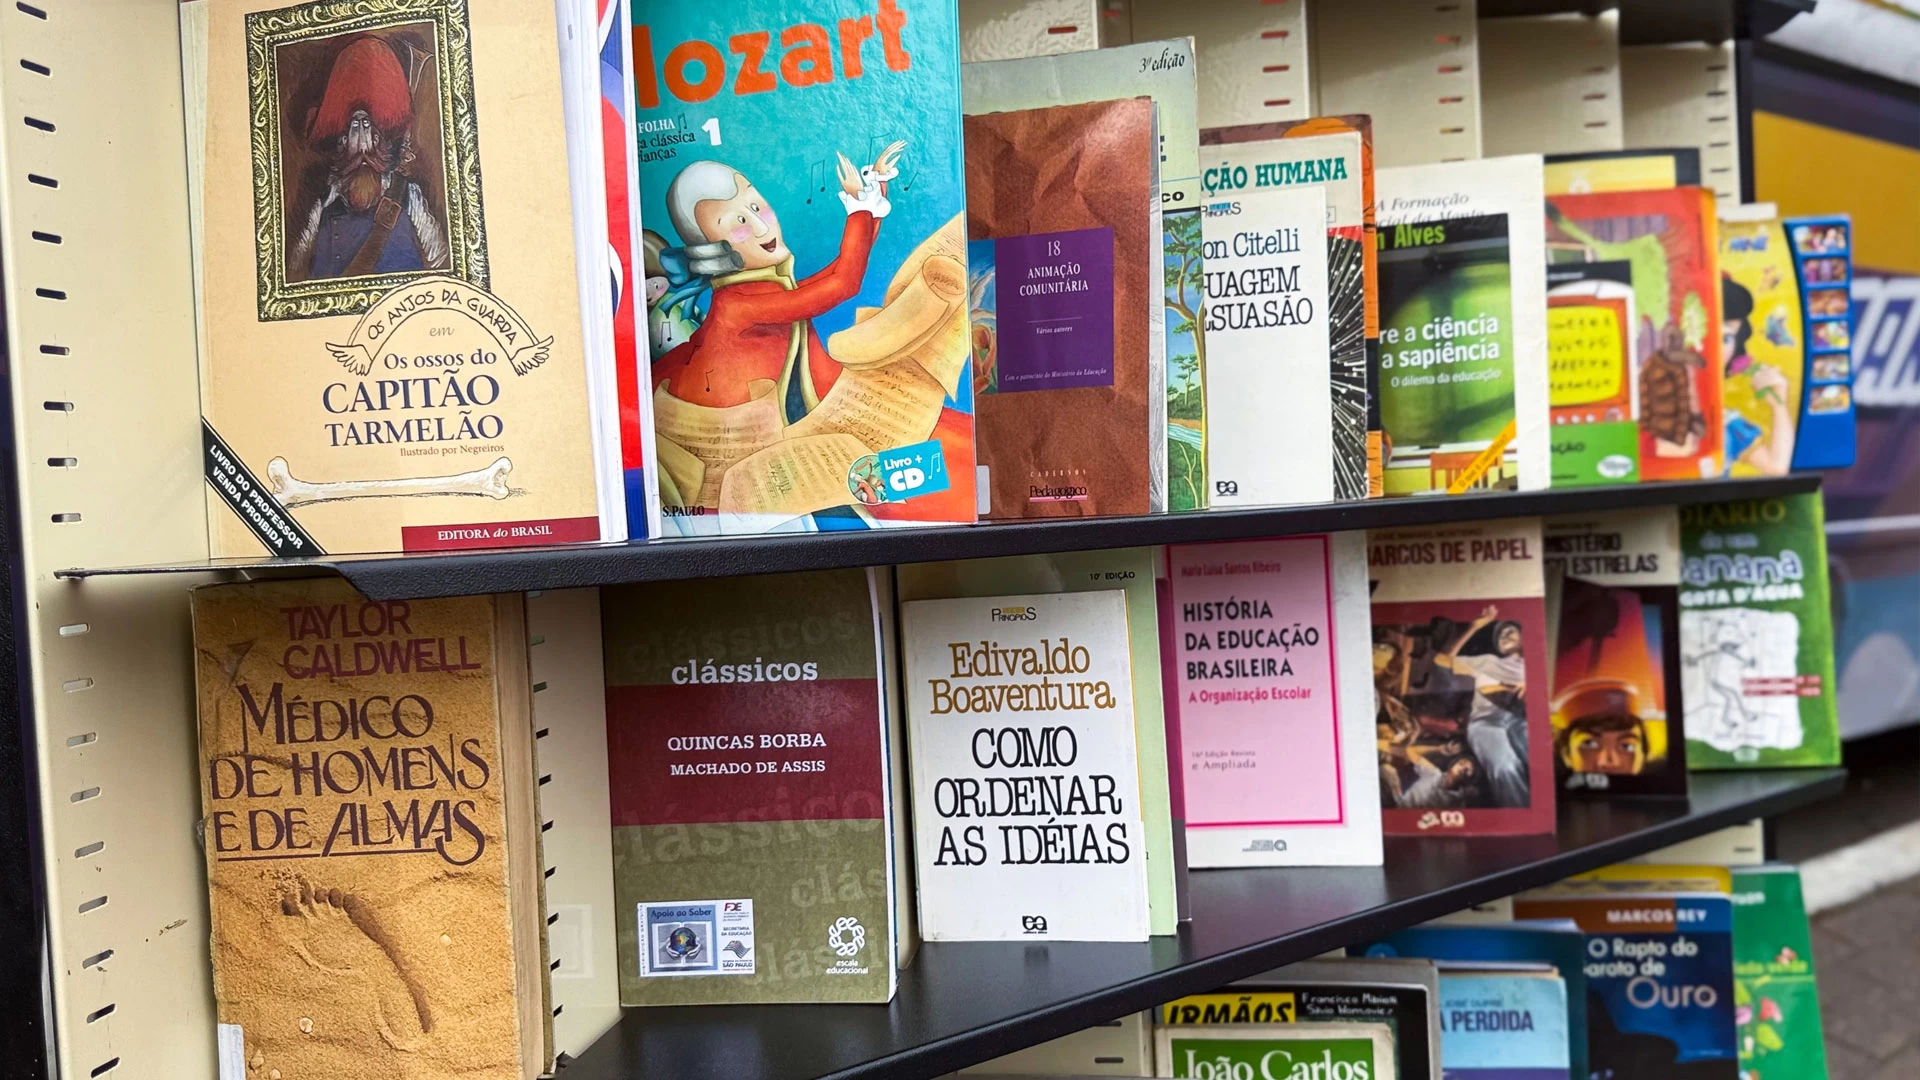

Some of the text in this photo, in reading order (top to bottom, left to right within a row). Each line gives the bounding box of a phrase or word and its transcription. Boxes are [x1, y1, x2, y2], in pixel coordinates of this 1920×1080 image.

[632, 0, 912, 109] ozart
[1152, 47, 1185, 71] edição
[638, 118, 676, 134] FOLHA
[701, 117, 722, 146] 1
[650, 131, 696, 148] clássica
[638, 147, 677, 163] ianças
[1200, 157, 1348, 197] ÇÃO HUMANA
[1375, 193, 1469, 211] A Formação
[1376, 214, 1407, 227] cial
[1233, 228, 1301, 257] Citelli
[1394, 223, 1446, 248] Alves
[1047, 240, 1061, 257] 18
[1027, 262, 1081, 279] ANIMAÇÃO
[1204, 265, 1301, 299] UAGEM
[1019, 278, 1089, 296] COMUNITÁRIA
[388, 290, 435, 324] ANJOS
[442, 289, 462, 305] DA
[467, 298, 518, 345] GUARDA
[1404, 326, 1416, 342] a
[1422, 313, 1499, 341] ciência
[429, 326, 455, 338] em
[384, 349, 497, 370] Os ossos do
[1382, 338, 1501, 369] a sapiência
[1391, 369, 1501, 387] O dilema da educação
[322, 369, 500, 414] CAPITÃO
[324, 410, 504, 447] TARMELÃO
[400, 444, 504, 457] Ilustrado por Negreiros
[883, 455, 913, 471] Livro
[889, 468, 925, 491] CD
[209, 444, 304, 549] LIVRO DO PROFESSOR
[211, 466, 285, 549] VENDA PROIBIDA
[662, 505, 705, 518] S.PAULO
[437, 525, 552, 541] EDITORA do BRASIL
[1441, 541, 1466, 564] DE
[1471, 538, 1532, 562] PAPEL
[1105, 571, 1135, 581] EDIÇÃO
[1224, 562, 1251, 574] Santos
[1252, 561, 1281, 573] Ribeiro
[1572, 553, 1658, 575] ESTRELAS
[1680, 550, 1804, 587] anana
[280, 600, 412, 641] TAYLOR
[1184, 596, 1273, 622] HISTÓRIA
[1185, 623, 1319, 652] DA EDUCAÇÃO
[283, 636, 481, 680] CALDWELL
[948, 637, 1091, 678] Edivaldo
[1187, 657, 1294, 680] BRASILEIRA
[672, 657, 818, 685] clássicos
[928, 676, 1116, 714] Boaventura
[1189, 686, 1311, 705] A Organização Escolar
[236, 682, 434, 752] MÉDICO
[667, 733, 827, 751] QUINCAS BORBA
[972, 726, 1077, 768] COMO
[210, 733, 490, 800] DE HOMENS
[670, 760, 826, 776] MACHADO DE ASSIS
[1192, 760, 1256, 771] e Ampliada
[934, 775, 1122, 817] ORDENAR
[213, 799, 486, 866] E DE ALMAS
[934, 817, 1130, 866] AS IDÉIAS
[651, 909, 674, 919] Apoio
[689, 908, 712, 916] Saber
[1606, 909, 1707, 923] MARCOS REY
[1588, 936, 1698, 961] O Rapto do
[826, 966, 868, 975] educacional
[1583, 958, 1666, 978] aroto de
[1302, 993, 1358, 1005] Francisco
[1626, 976, 1717, 1009] Ouro
[1169, 996, 1292, 1023] IRMÃOS
[1451, 1010, 1534, 1032] PERDIDA
[1181, 1049, 1369, 1080] João Carlos
